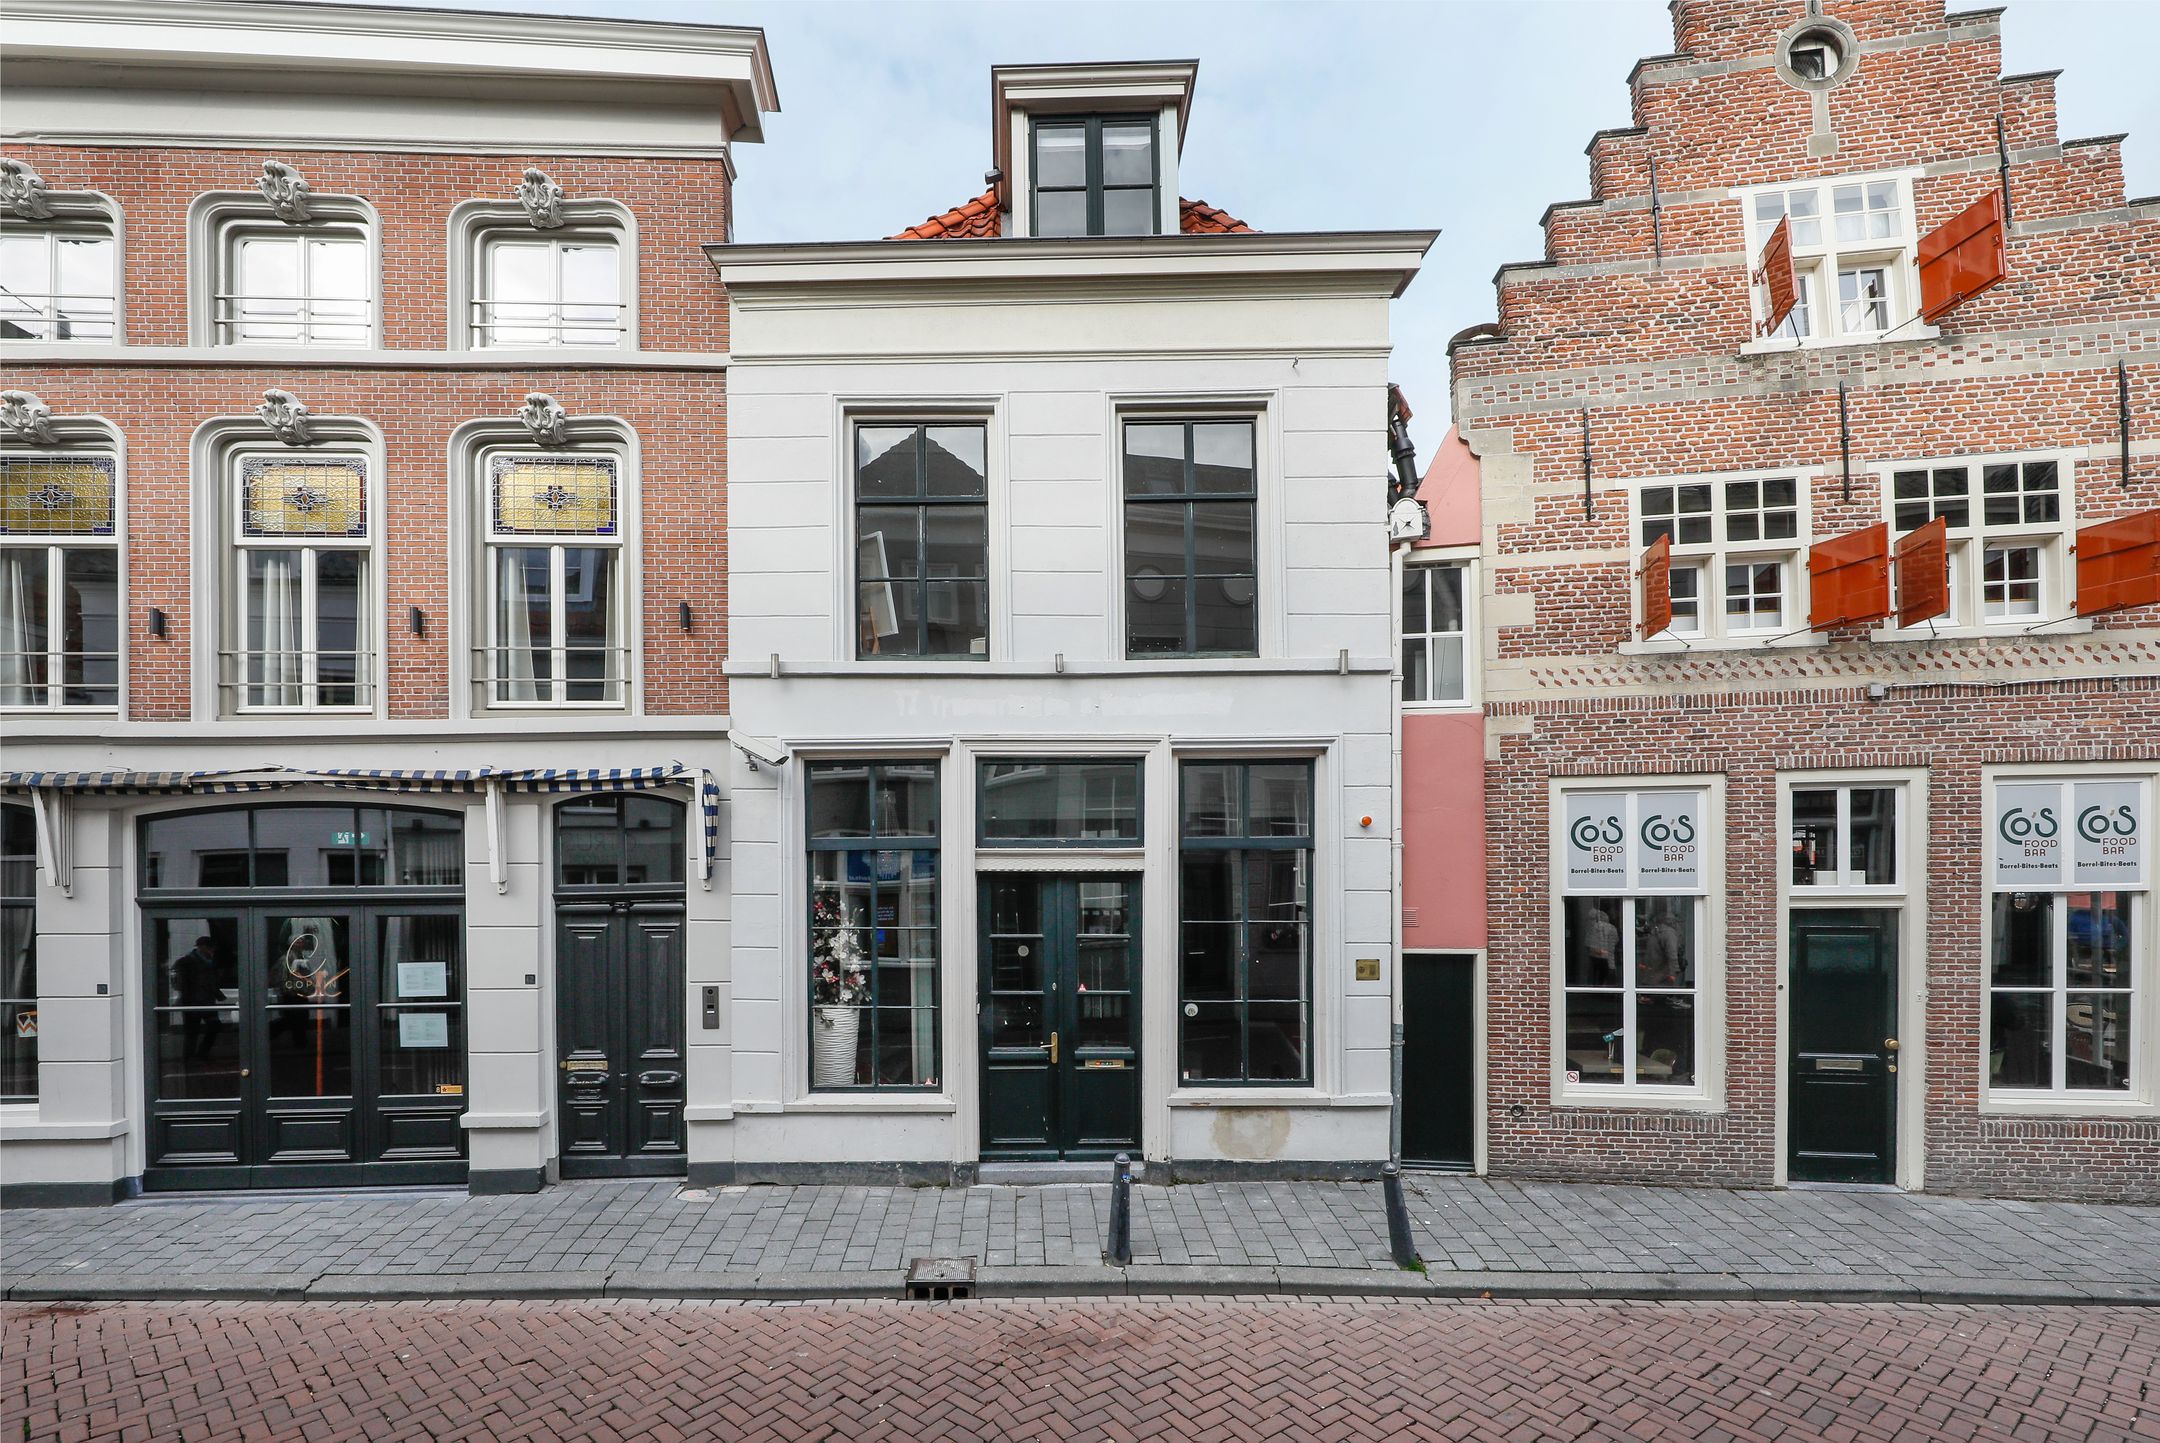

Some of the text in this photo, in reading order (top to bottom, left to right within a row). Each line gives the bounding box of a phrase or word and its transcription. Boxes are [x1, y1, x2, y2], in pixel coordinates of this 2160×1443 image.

[2024, 840, 2058, 848] FOOD
[2102, 838, 2137, 846] FOOD
[1593, 846, 1624, 854] FOOD
[1664, 845, 1695, 853] FOOD
[2102, 847, 2125, 855] BAR
